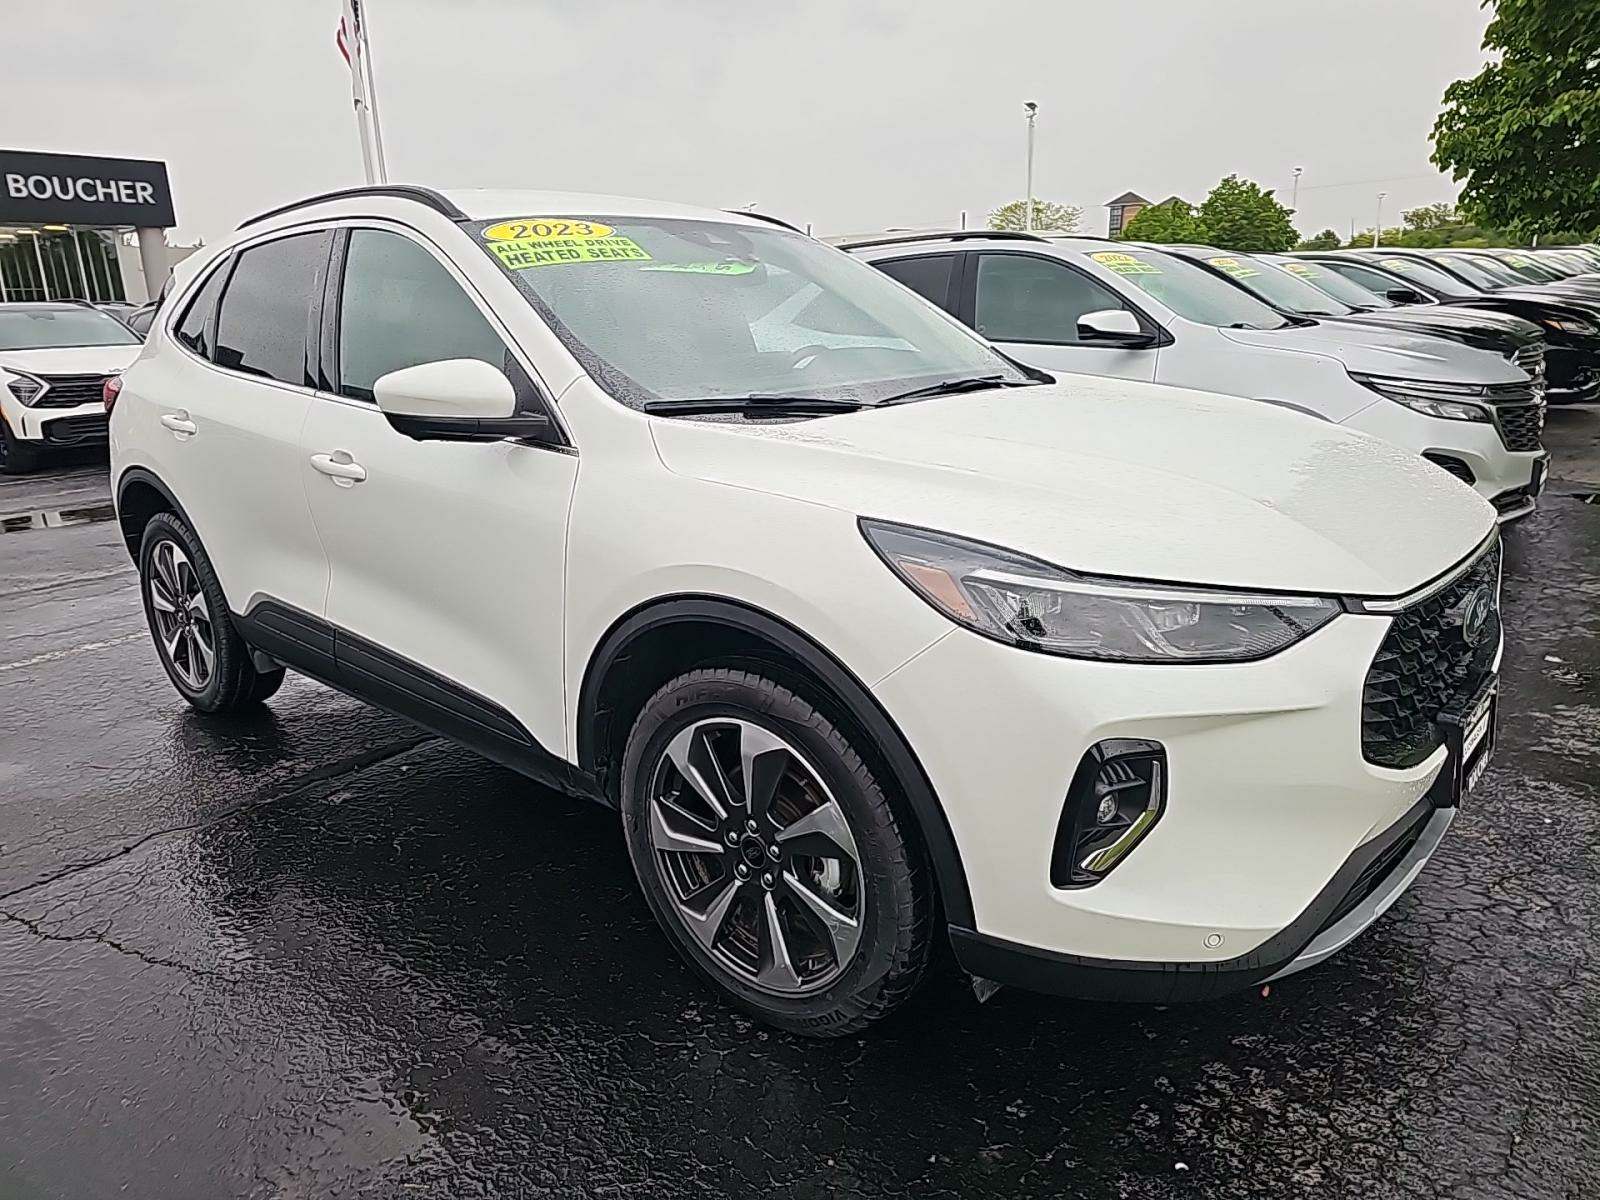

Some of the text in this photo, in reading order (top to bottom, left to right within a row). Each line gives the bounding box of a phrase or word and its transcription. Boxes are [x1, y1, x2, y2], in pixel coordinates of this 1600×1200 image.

[5, 173, 157, 204] BOUCHER
[509, 222, 595, 239] 2023
[496, 237, 631, 254] ALL WHEEL DRIVE
[505, 247, 645, 267] HEATED SEATS
